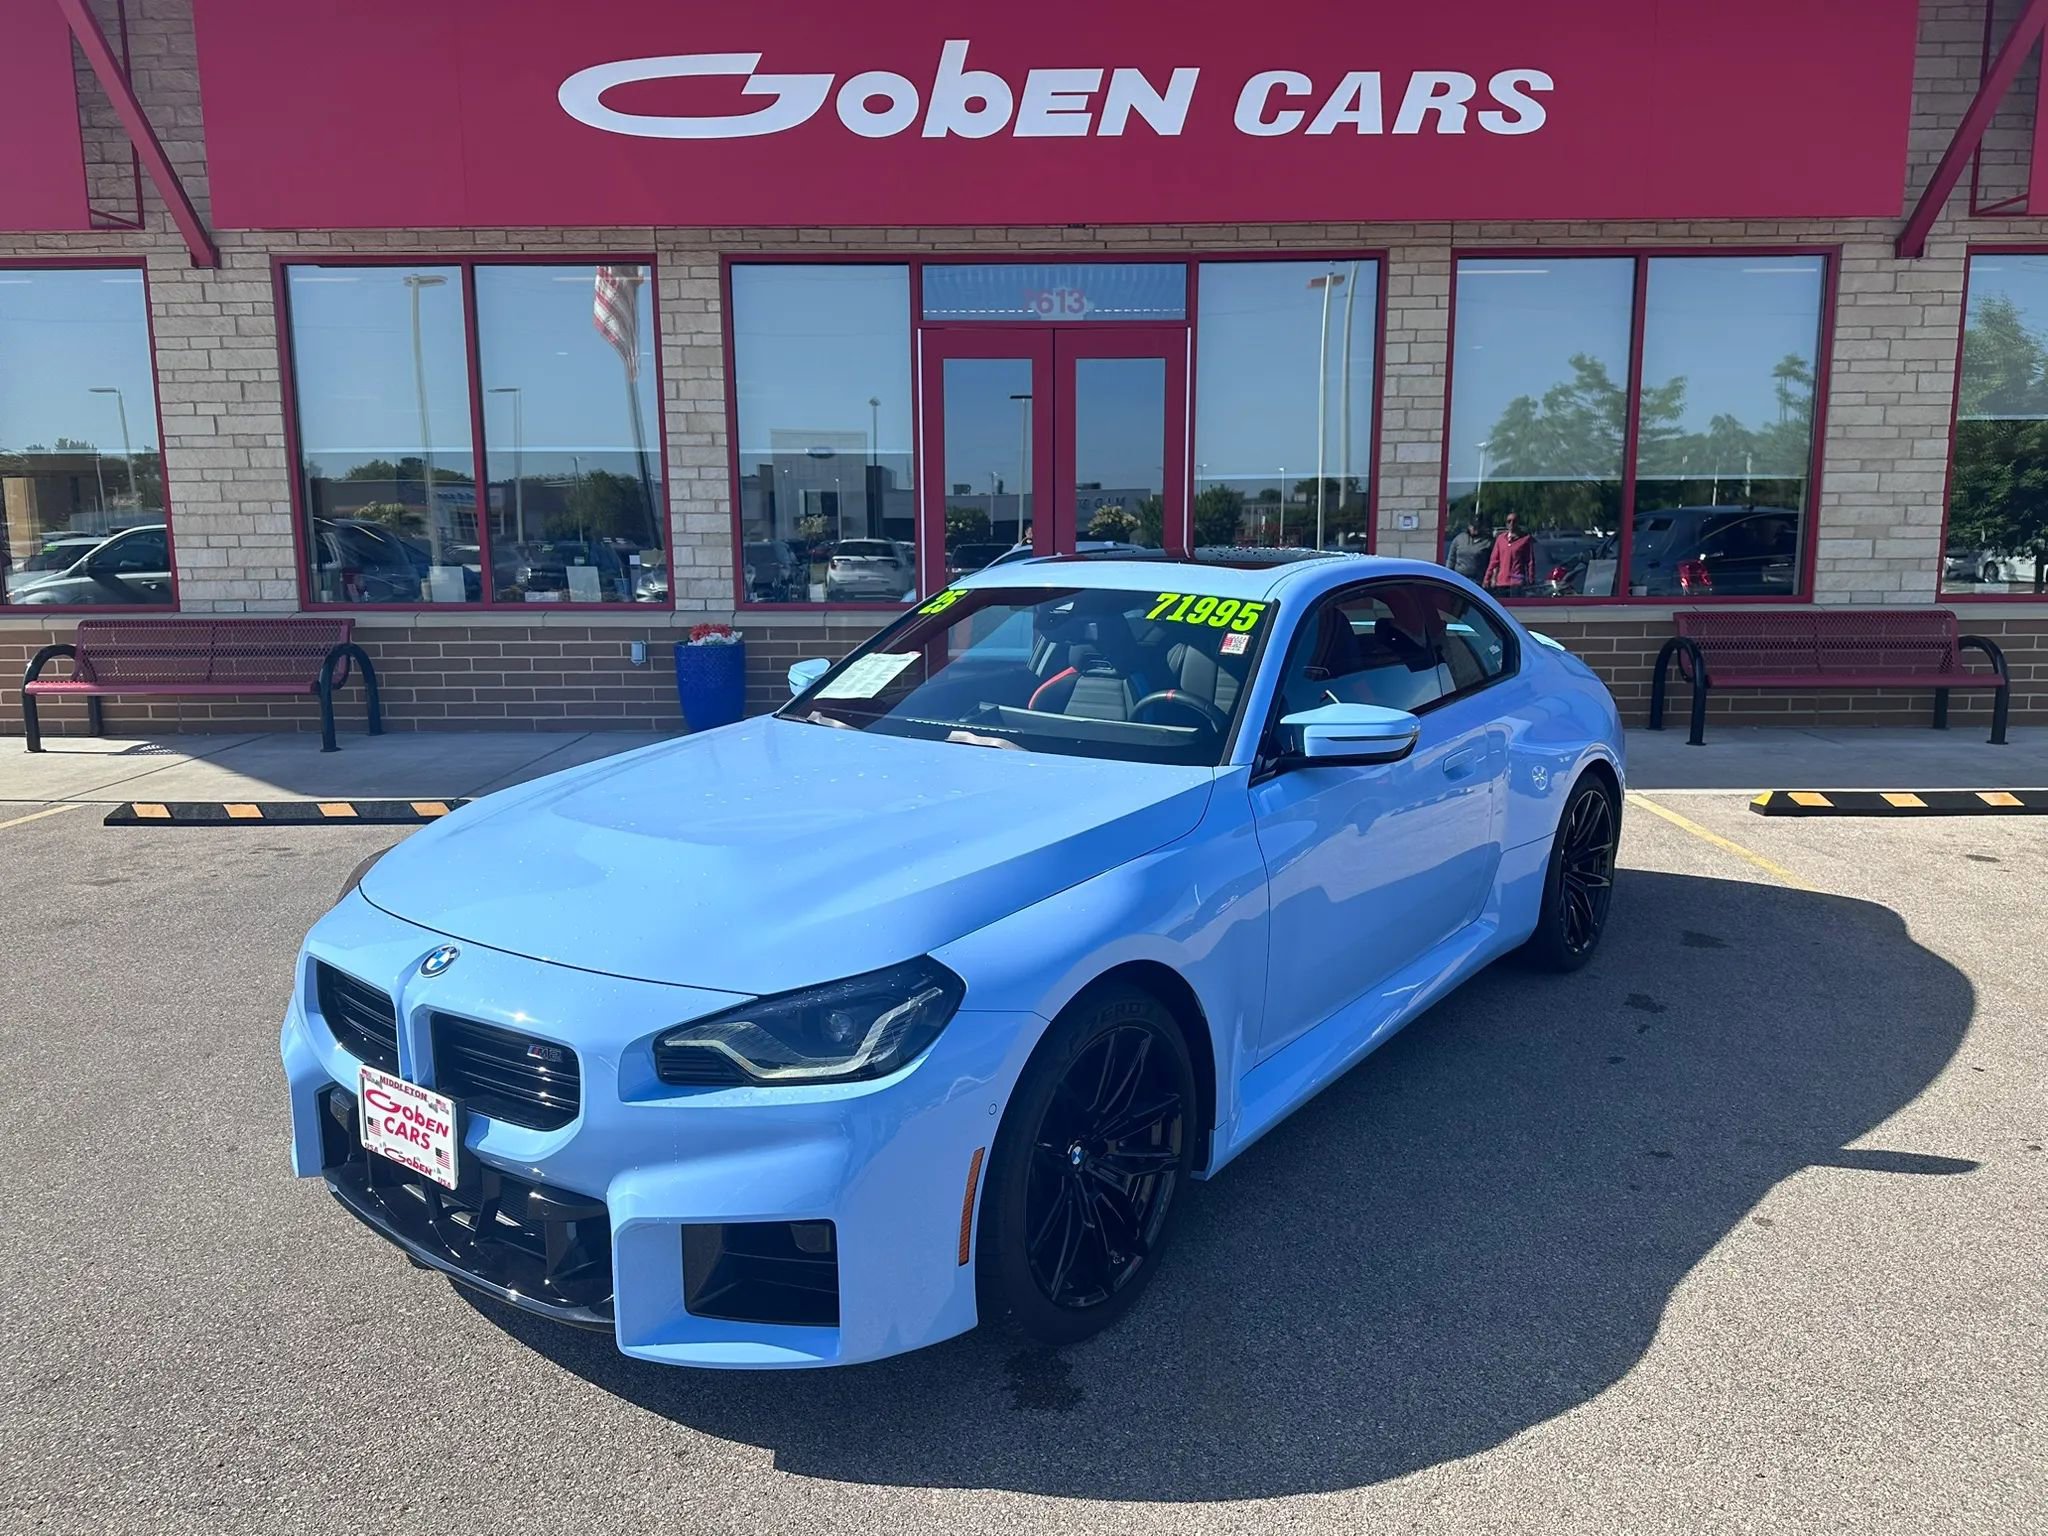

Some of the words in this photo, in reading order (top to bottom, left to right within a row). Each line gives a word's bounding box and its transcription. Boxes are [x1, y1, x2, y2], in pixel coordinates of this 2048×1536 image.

[1233, 69, 1555, 137] CARS
[918, 589, 969, 614] 25
[1145, 592, 1267, 632] 71995
[379, 1075, 428, 1101] MIDDLETON
[364, 1142, 379, 1154] USA
[383, 1116, 431, 1150] CARS
